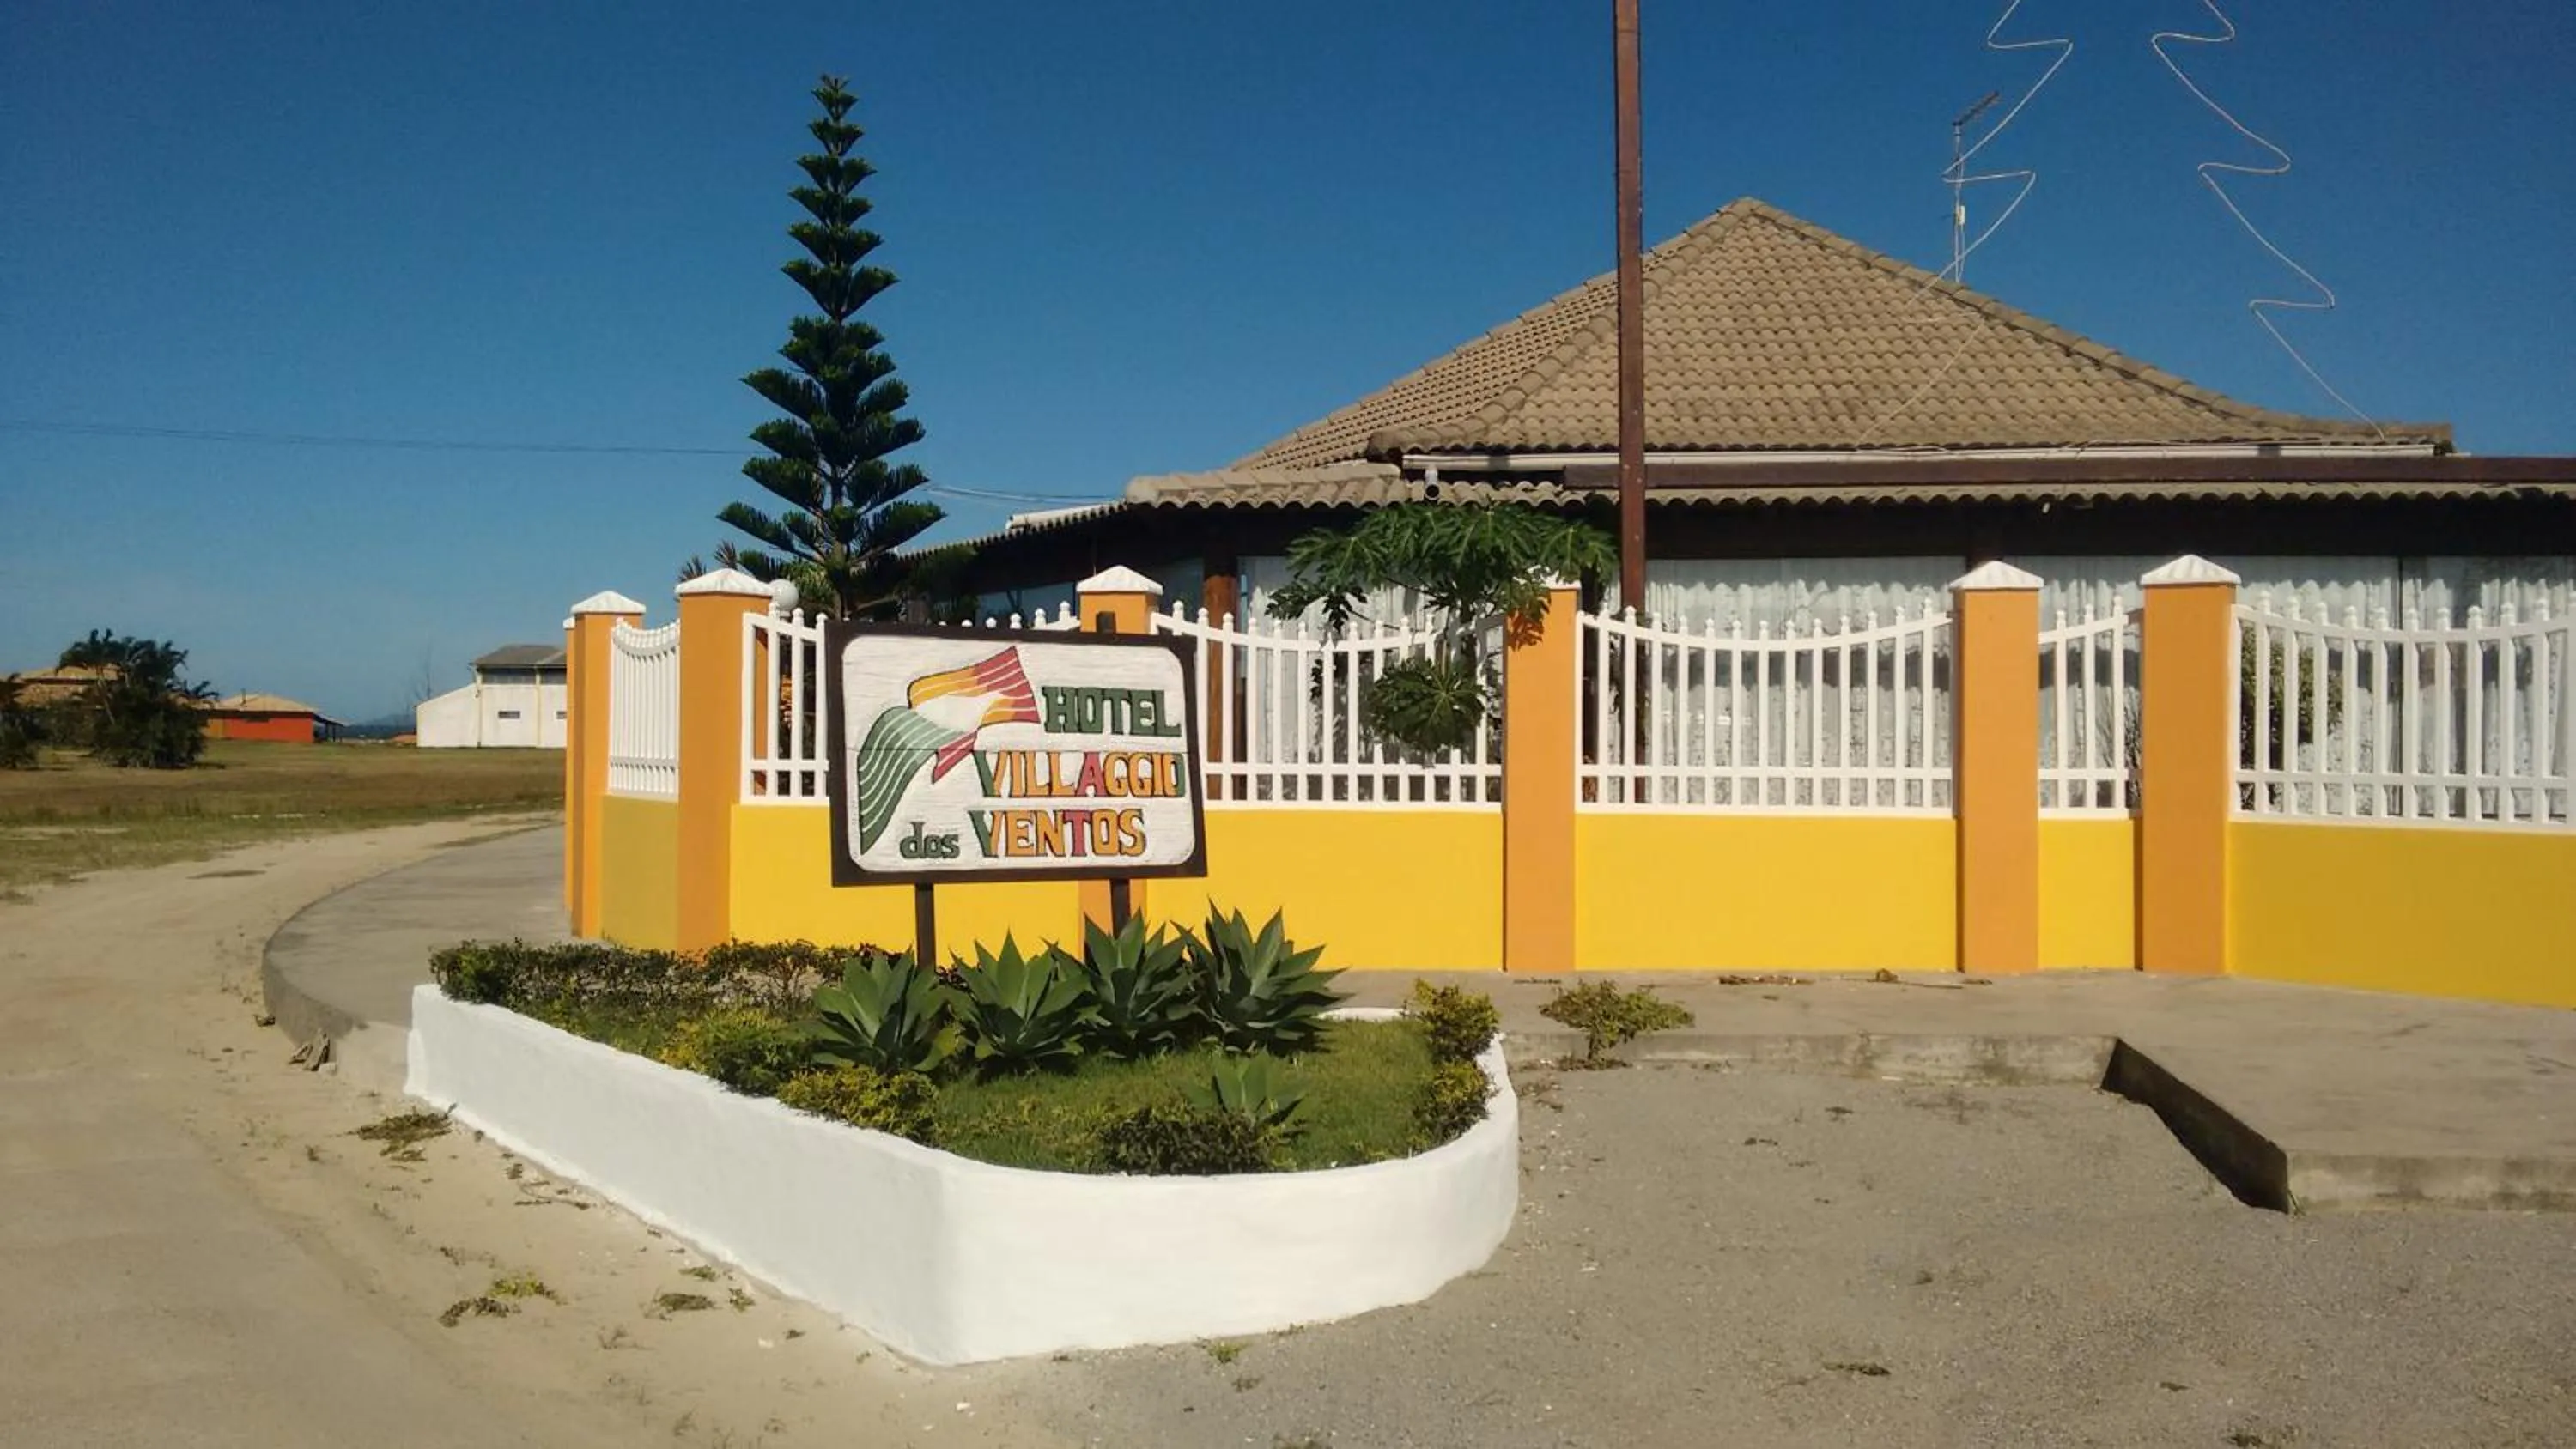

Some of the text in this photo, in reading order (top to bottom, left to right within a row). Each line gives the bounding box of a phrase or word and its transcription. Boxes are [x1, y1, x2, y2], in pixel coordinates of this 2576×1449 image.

[1042, 686, 1182, 737] HOTEL
[972, 750, 1186, 797] VILLAGGIO
[899, 809, 1147, 858] dos VENTOS
